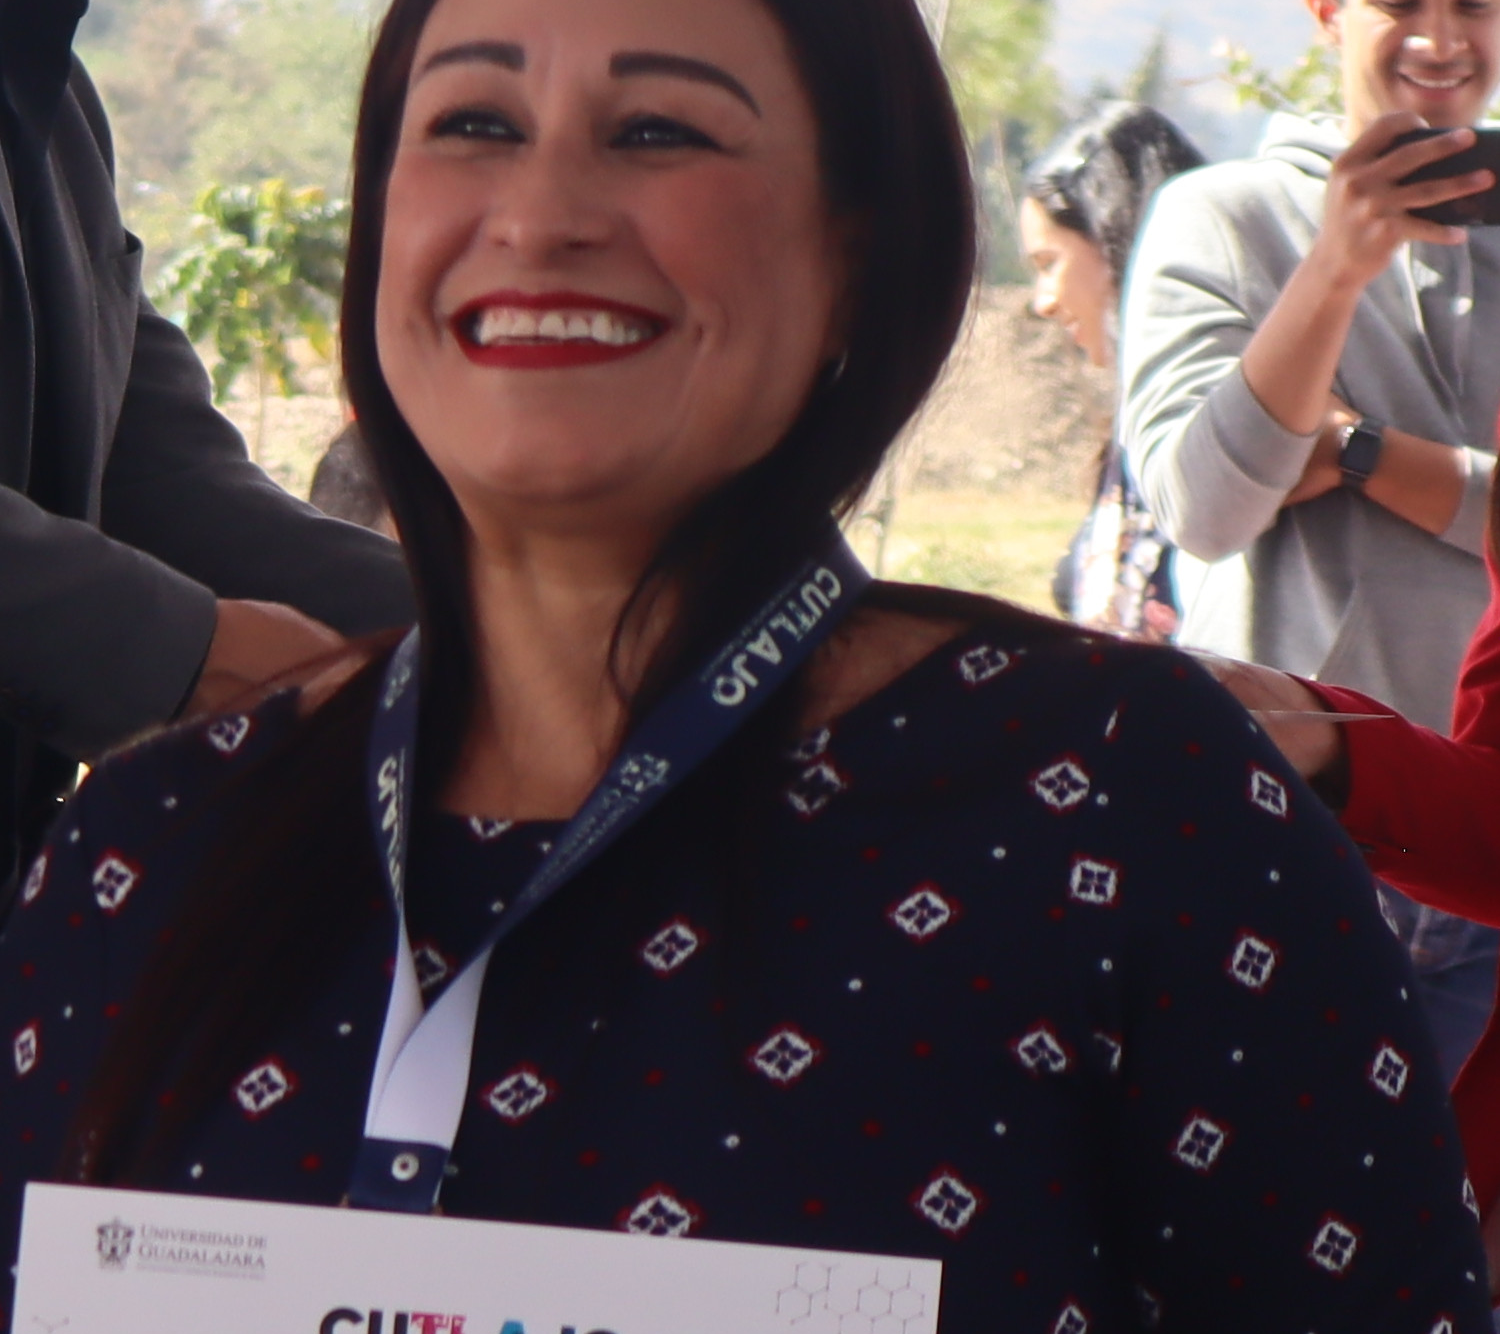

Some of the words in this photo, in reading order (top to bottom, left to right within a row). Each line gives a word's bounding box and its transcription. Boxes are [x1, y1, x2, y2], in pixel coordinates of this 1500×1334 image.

[712, 568, 841, 706] CUTLAJO
[140, 1223, 244, 1247] UNIVERSIDAD
[139, 1244, 265, 1268] GUADALAJARA
